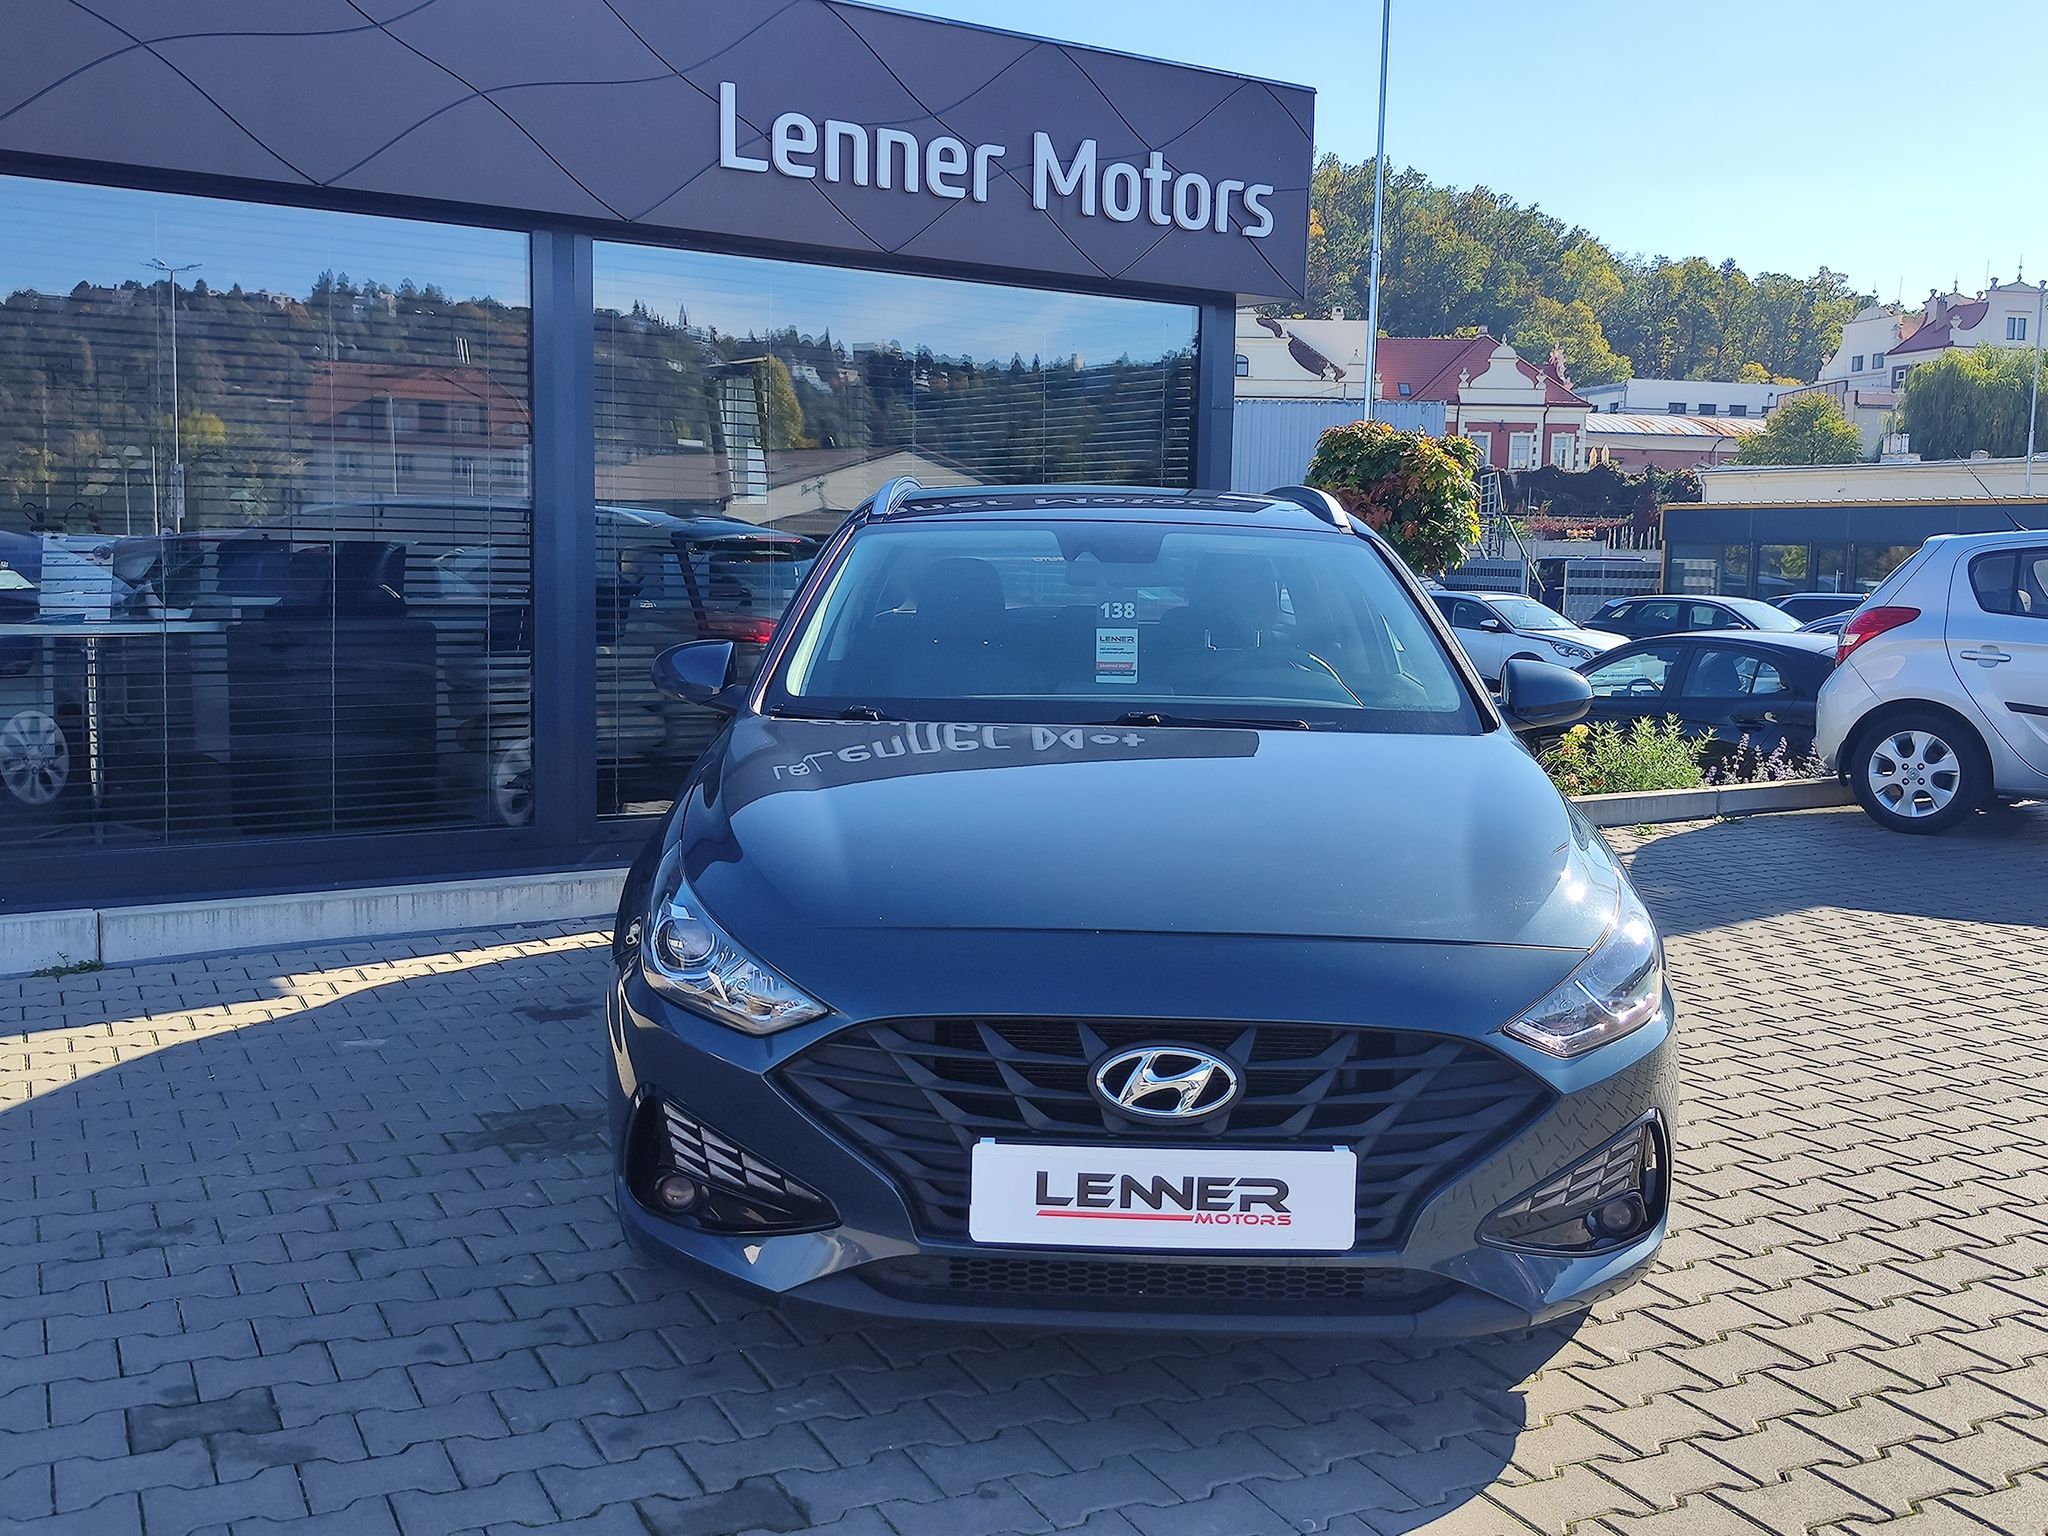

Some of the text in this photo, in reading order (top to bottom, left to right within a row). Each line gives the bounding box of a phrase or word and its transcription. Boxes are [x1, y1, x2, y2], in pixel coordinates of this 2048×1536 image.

[719, 81, 1275, 239] Lenner Motors
[1100, 602, 1136, 619] 138
[1035, 1170, 1292, 1213] LENNER
[1192, 1212, 1292, 1227] MOTORS
